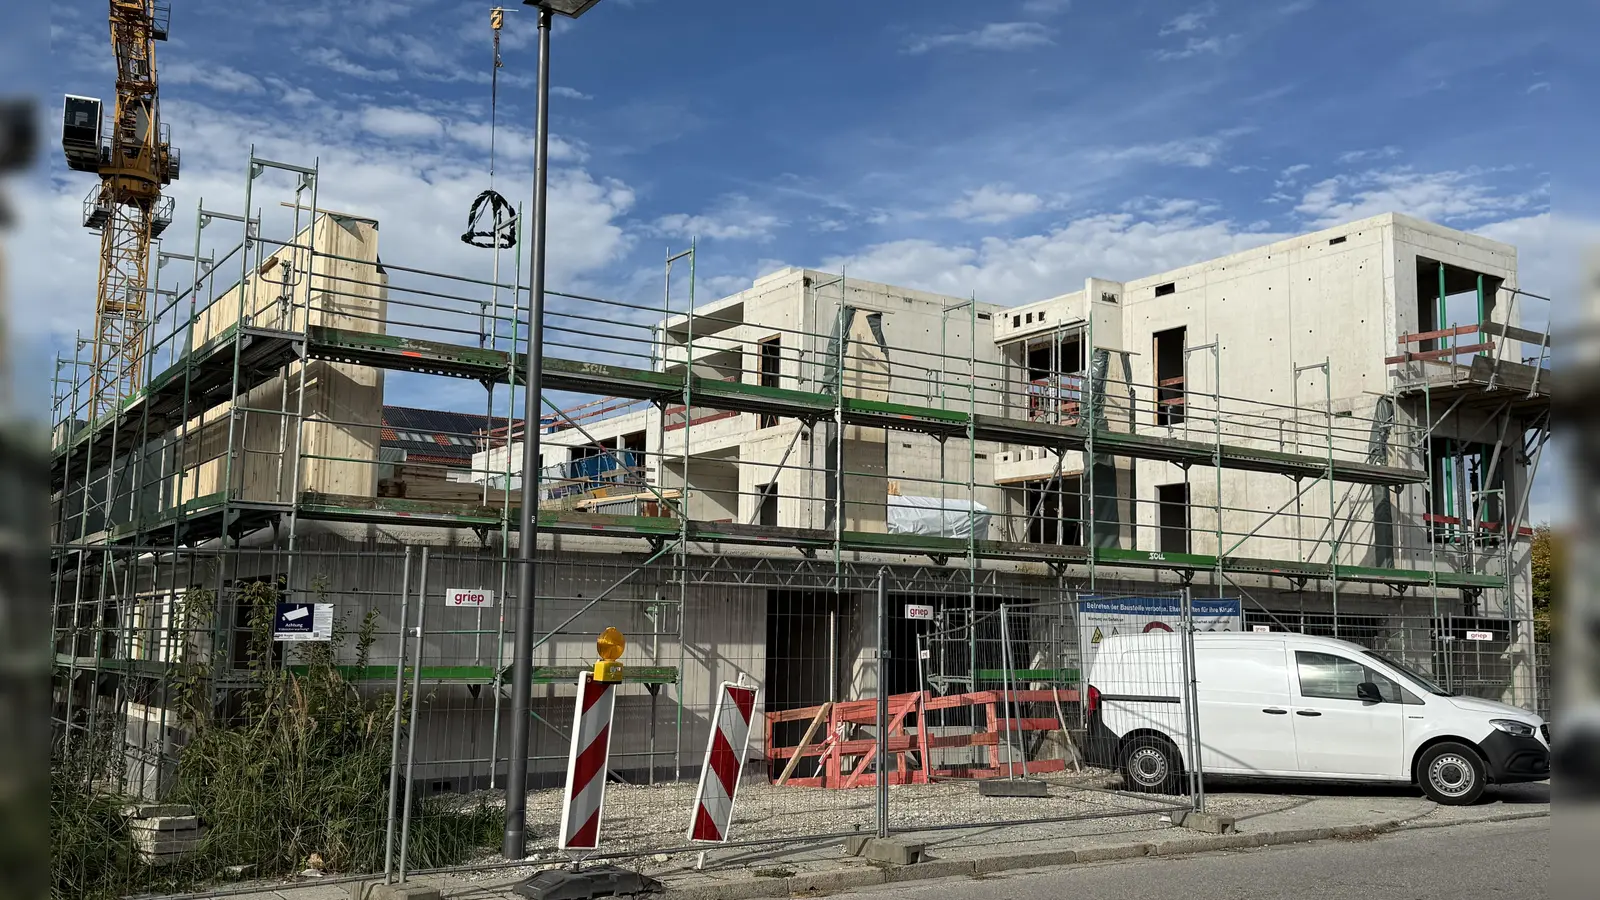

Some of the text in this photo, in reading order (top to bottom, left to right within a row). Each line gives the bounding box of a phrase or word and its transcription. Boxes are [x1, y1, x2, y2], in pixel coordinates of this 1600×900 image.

[454, 592, 485, 605] griep
[1086, 602, 1110, 610] Betreten
[910, 608, 928, 618] griep
